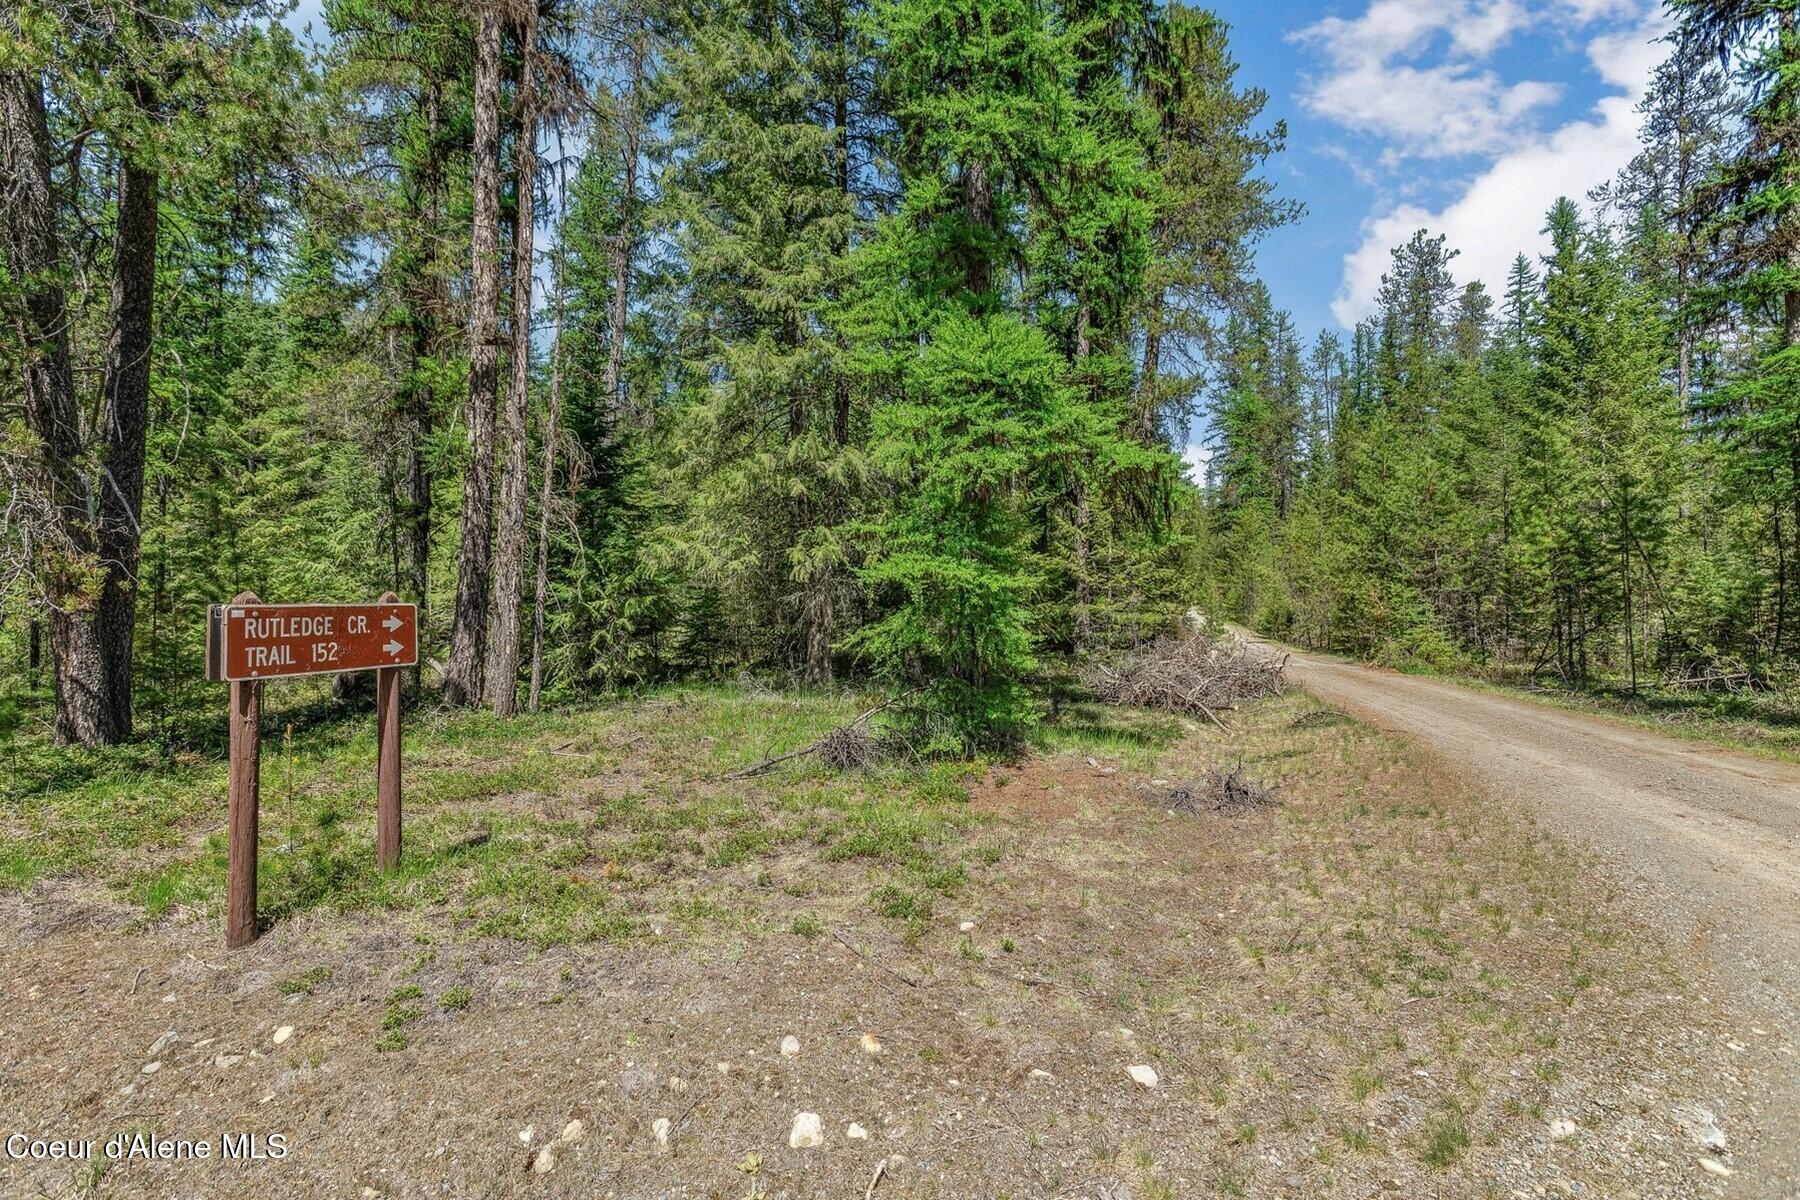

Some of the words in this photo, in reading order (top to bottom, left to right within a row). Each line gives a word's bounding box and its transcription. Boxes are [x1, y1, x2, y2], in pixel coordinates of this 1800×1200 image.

[244, 616, 334, 639] RUTLEDGE
[347, 615, 371, 634] CR.
[245, 645, 296, 667] TRAIL
[311, 642, 338, 662] 152
